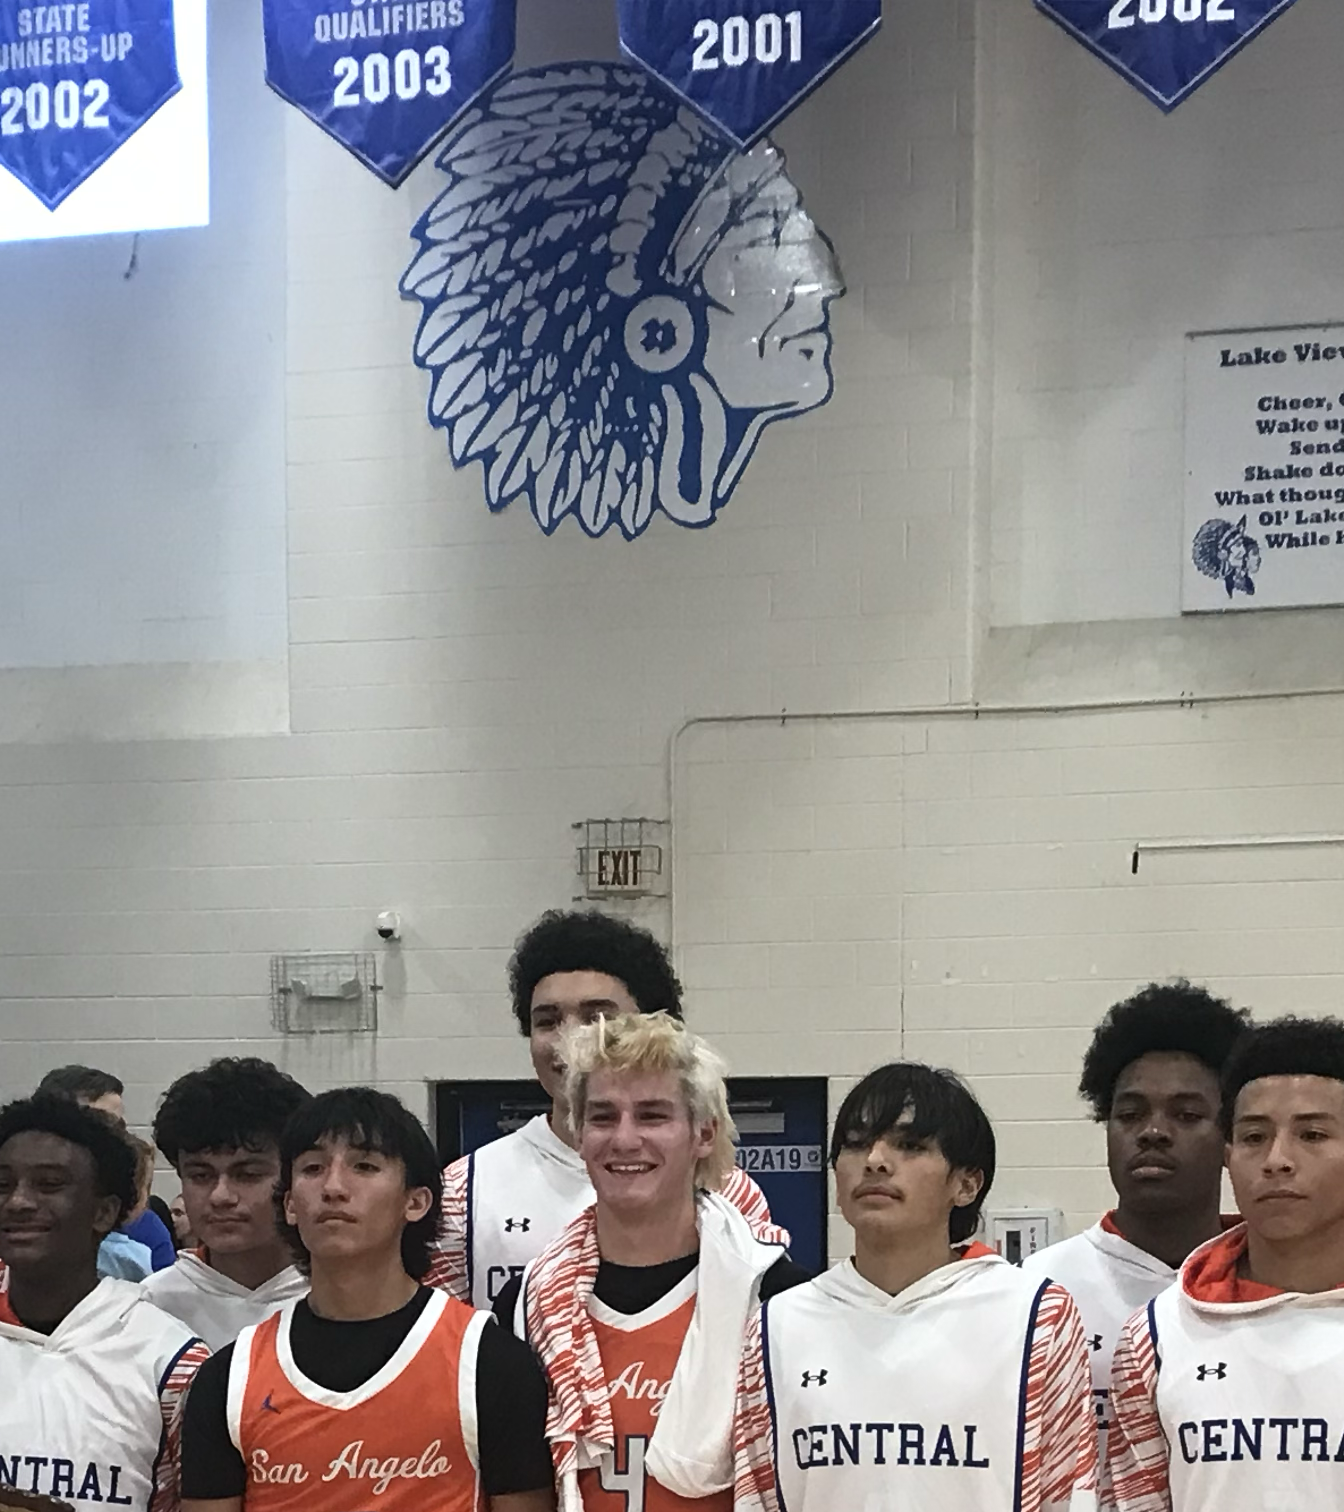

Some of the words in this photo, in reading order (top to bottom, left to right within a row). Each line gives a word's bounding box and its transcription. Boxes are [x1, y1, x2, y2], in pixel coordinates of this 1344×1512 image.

[18, 3, 91, 36] STATE
[315, 1, 464, 43] QUALIFIERS
[692, 11, 802, 71] 2001
[333, 45, 452, 108] 2003
[1, 79, 110, 136] 2002
[1220, 347, 1287, 367] Lake
[1256, 418, 1319, 435] Wake
[1244, 464, 1313, 481] Shake
[1214, 489, 1275, 507] What
[1265, 531, 1330, 549] While
[598, 850, 641, 886] EXIT
[792, 1423, 990, 1469] CENTRAL
[251, 1449, 308, 1483] San
[322, 1439, 452, 1495] Angelo
